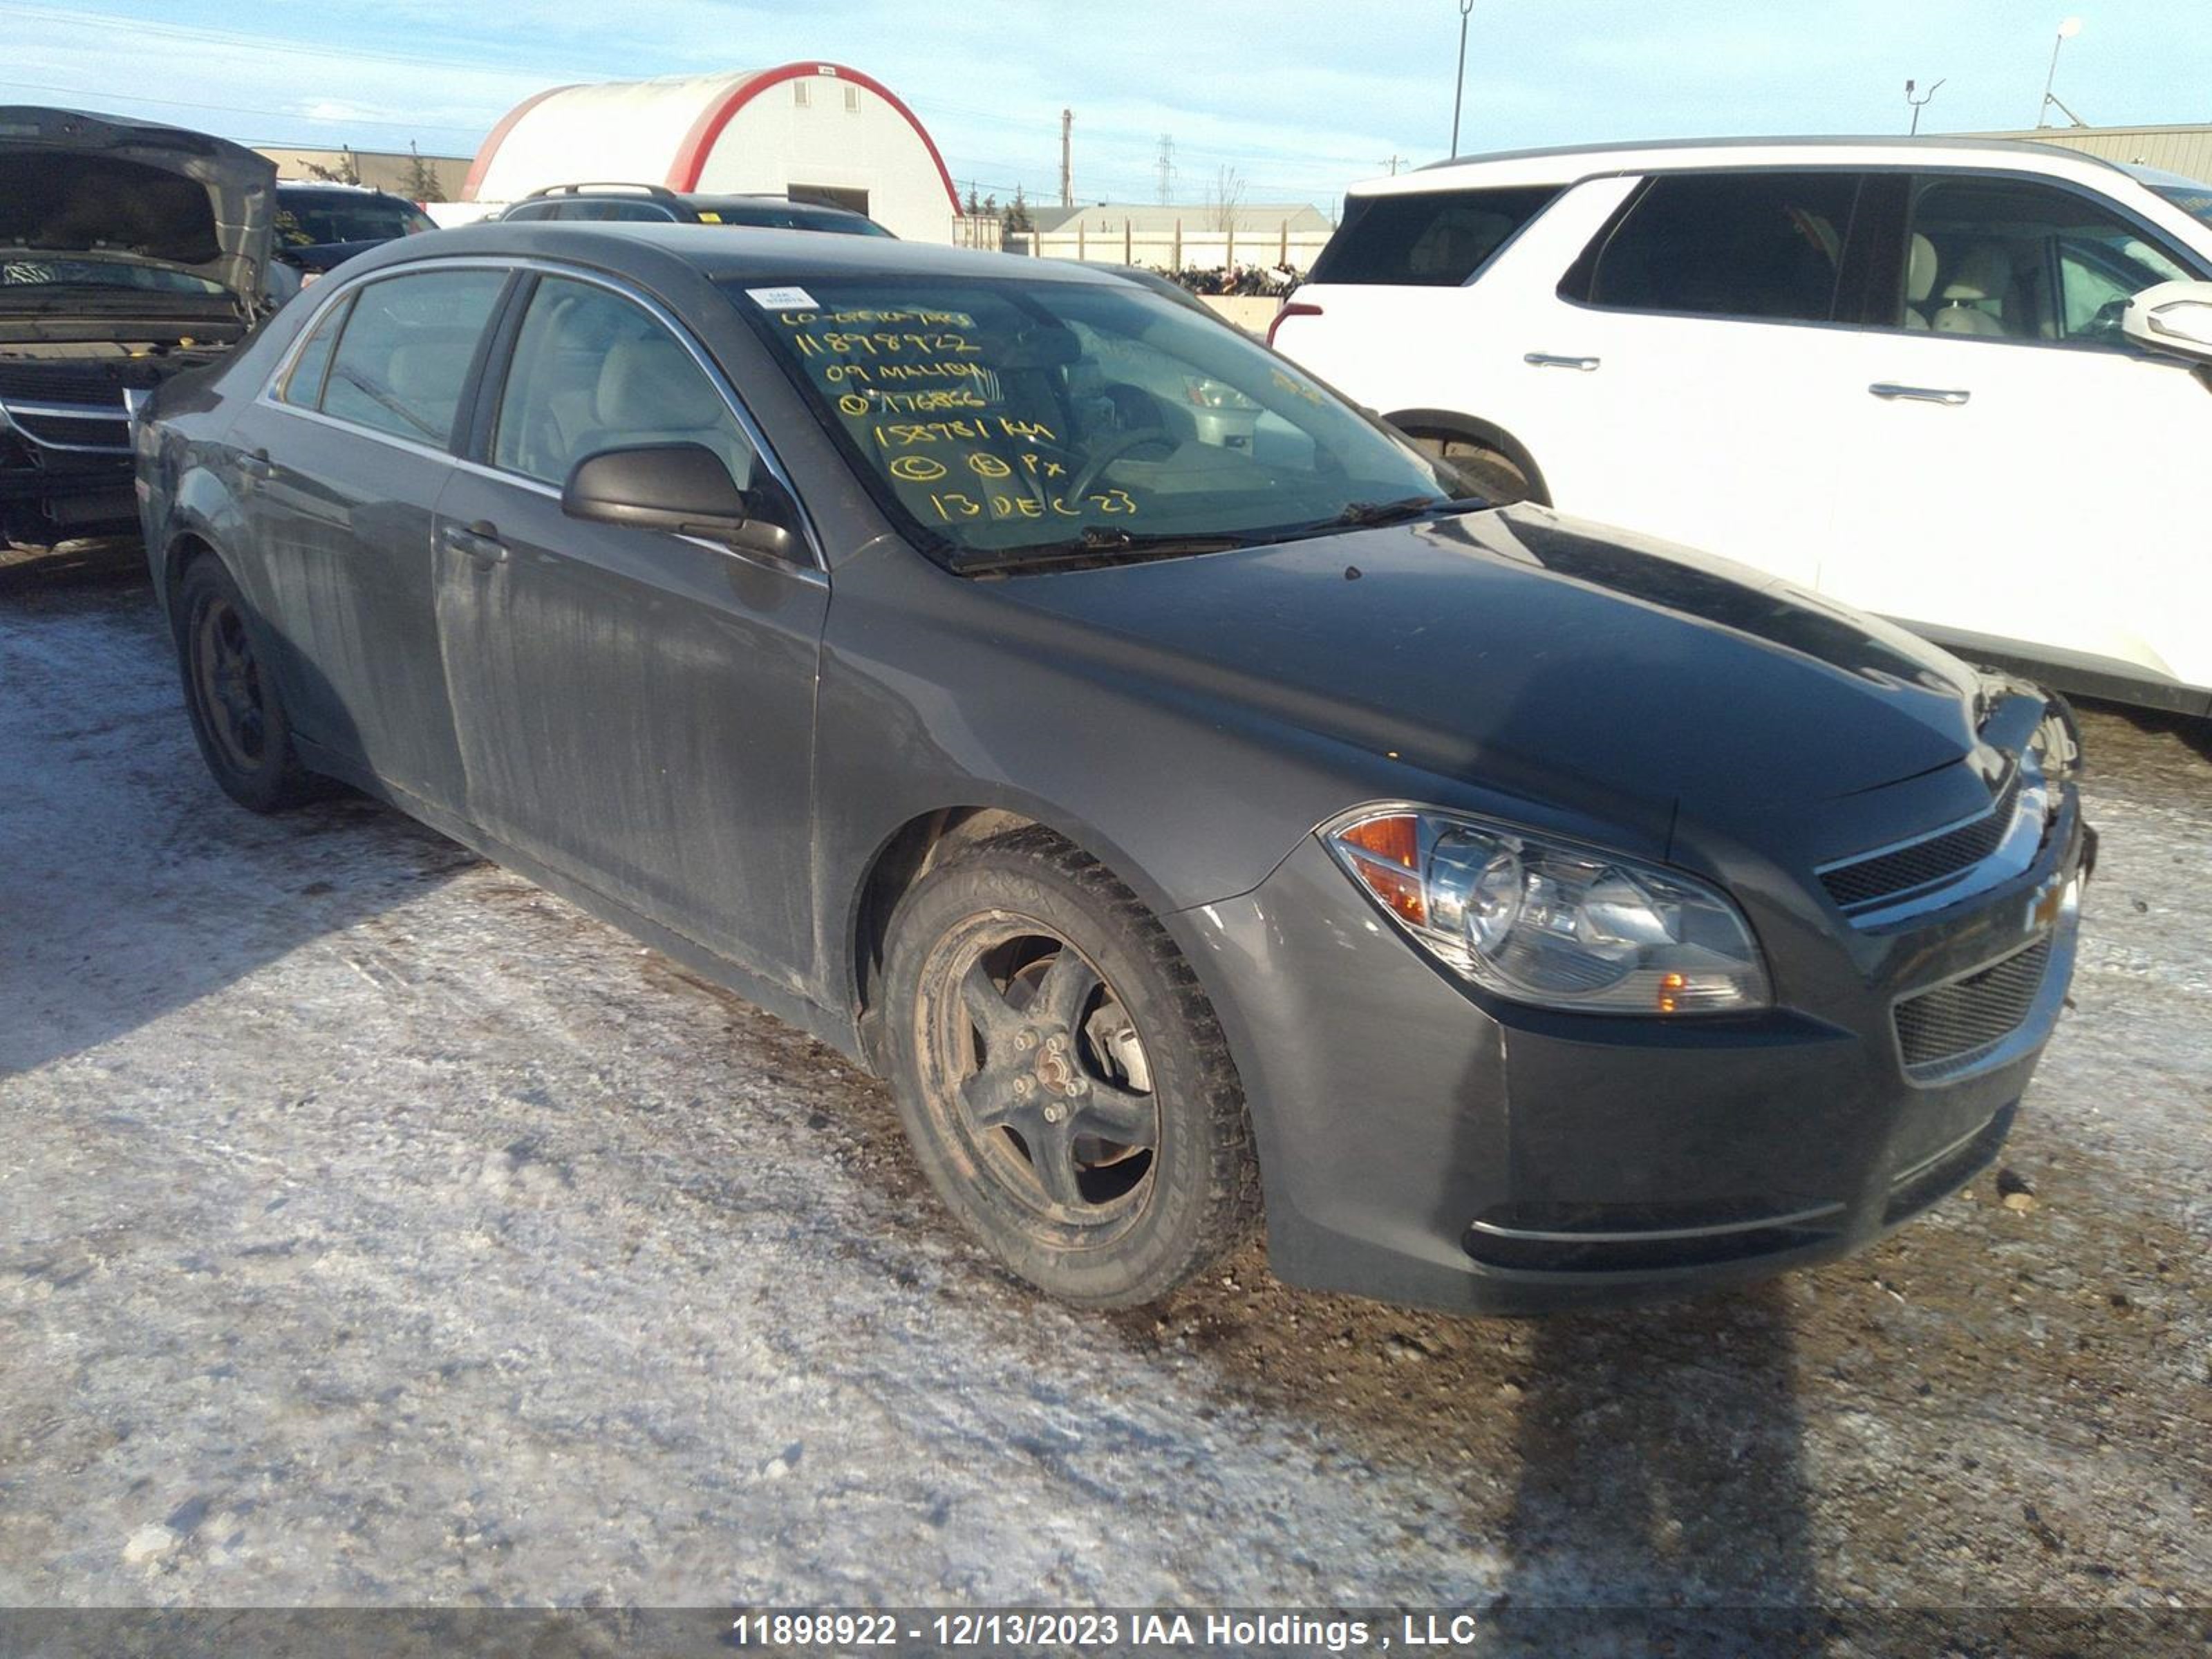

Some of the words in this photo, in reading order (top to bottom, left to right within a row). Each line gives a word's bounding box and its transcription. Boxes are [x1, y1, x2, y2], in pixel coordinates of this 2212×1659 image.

[796, 332, 982, 357] 11898922
[826, 365, 870, 381] 09
[929, 492, 980, 521] 13
[1089, 489, 1136, 514] 23
